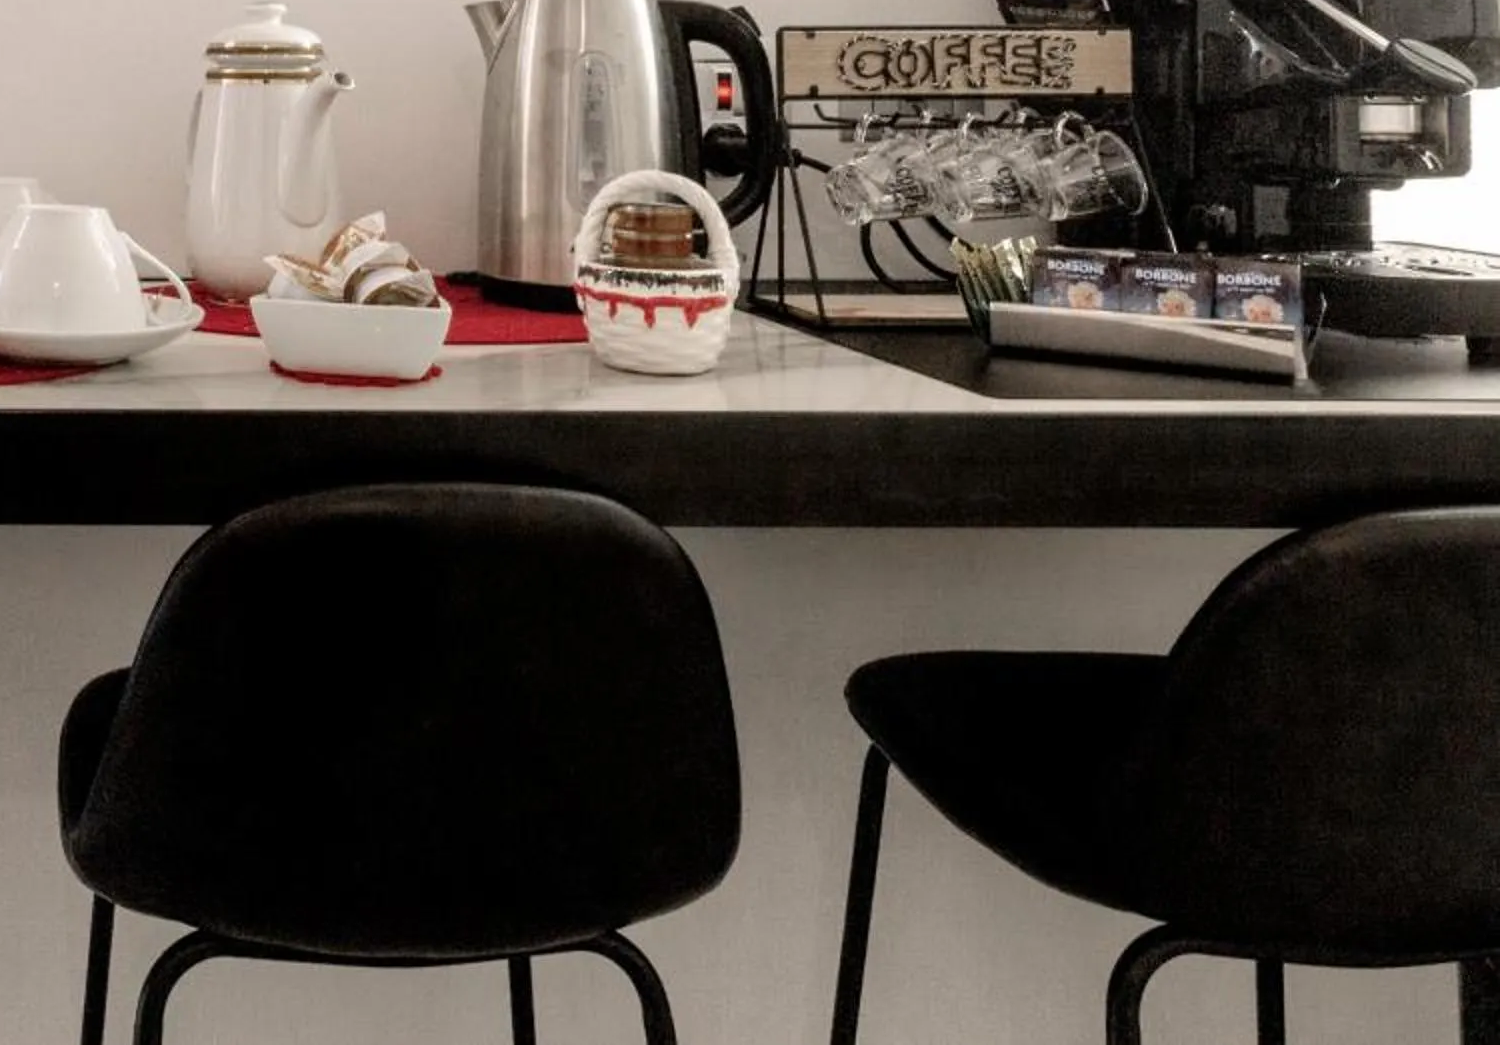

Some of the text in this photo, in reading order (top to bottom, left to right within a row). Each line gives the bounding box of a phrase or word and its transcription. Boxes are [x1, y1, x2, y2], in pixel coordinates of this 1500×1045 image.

[1047, 259, 1106, 276] BORBONE
[1134, 267, 1198, 285] BORBONE
[1216, 273, 1282, 287] BORBONE
